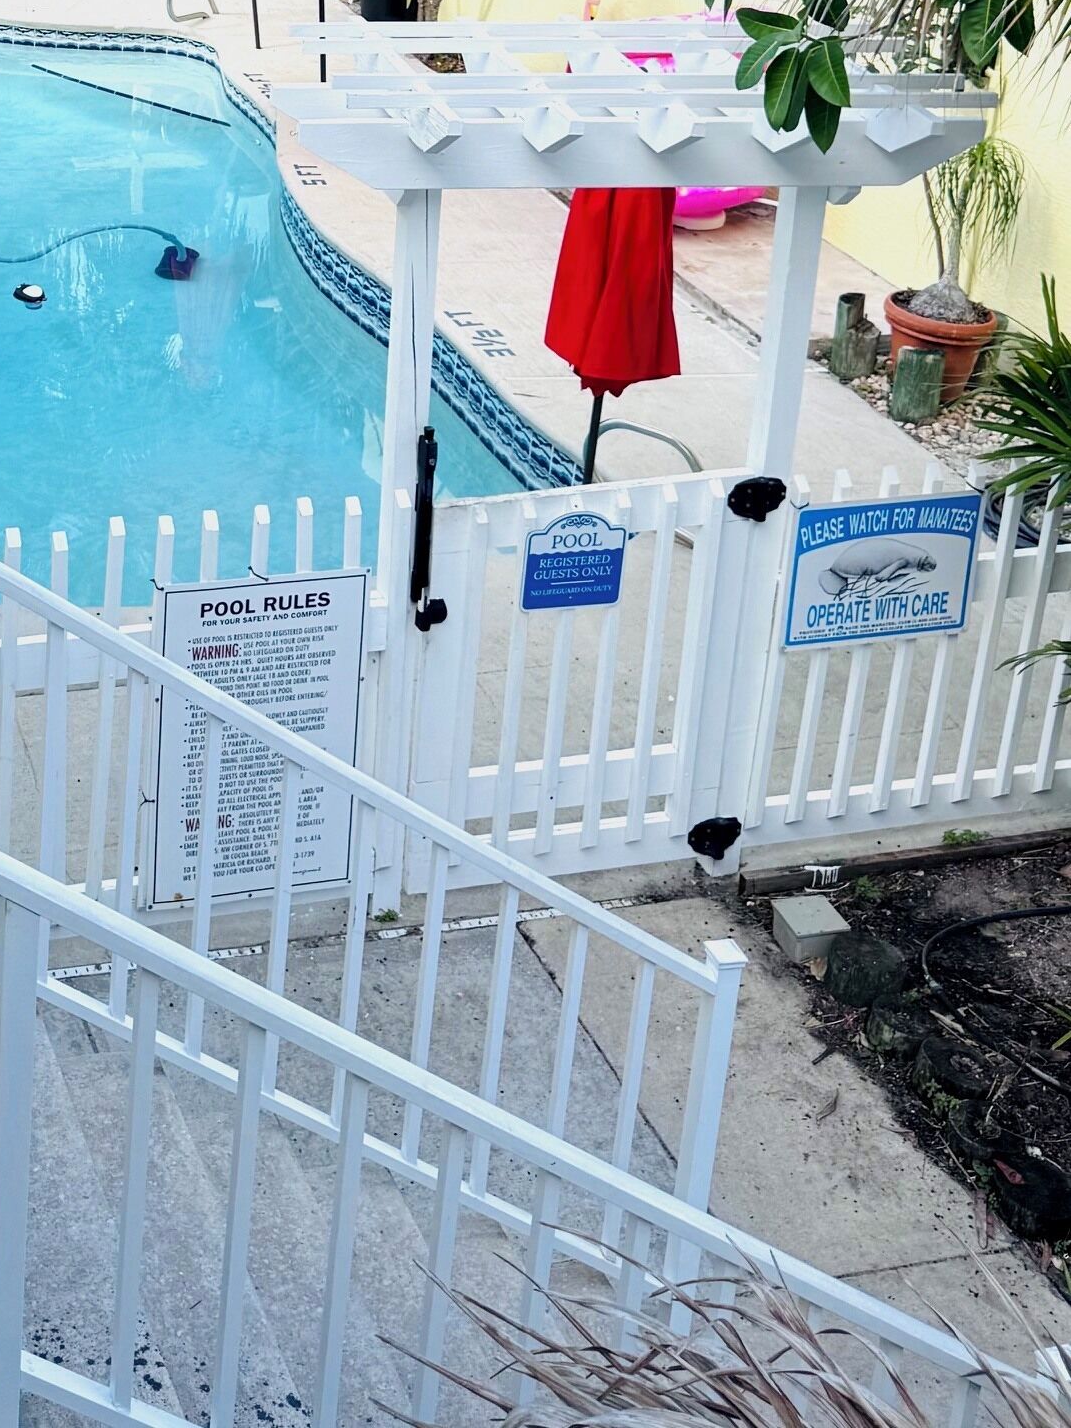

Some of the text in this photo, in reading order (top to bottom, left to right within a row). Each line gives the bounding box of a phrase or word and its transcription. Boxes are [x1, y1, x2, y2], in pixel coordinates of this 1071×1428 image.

[293, 164, 322, 176] FT
[443, 311, 485, 327] FT
[800, 506, 977, 549] PLEASE WATCH FOR MANATEES
[552, 532, 603, 549] POOL
[539, 554, 611, 568] REGISTERED
[533, 565, 613, 581] GUESTS ONLY
[542, 586, 580, 596] LIFEGUARD
[593, 584, 614, 592] DUTY
[200, 591, 331, 618] POOL RULES
[806, 600, 872, 628] OPERATE
[875, 596, 908, 620] WITH
[911, 591, 950, 617] CARE
[201, 609, 327, 627] FOR YOUR SAFETY AND COMFORT
[211, 634, 225, 643] POOL
[233, 631, 263, 641] RESTRICTED
[264, 630, 271, 638] TO
[272, 627, 302, 637] REGISTERED
[303, 625, 323, 634] GUESTS
[323, 624, 338, 632] ONLY
[191, 634, 324, 661] WARNING: USE POOL AT YOUR OWN RISK
[243, 644, 309, 657] NO LIFEGUARD ON DUTY
[191, 662, 205, 670] POOL
[207, 661, 213, 669] IS
[214, 660, 230, 668] OPEN
[256, 655, 273, 664] QUIET
[274, 653, 294, 662] HOURS
[295, 652, 306, 660] ARE
[306, 649, 336, 659] OBSERVED
[221, 668, 228, 676] 10
[229, 667, 238, 675] PM
[250, 665, 260, 673] AM
[261, 663, 273, 672] AND
[275, 662, 285, 670] ARE
[287, 659, 318, 669] RESTRICTED
[319, 658, 331, 666] FOR
[213, 675, 235, 685] ADULTS
[236, 674, 251, 682] ONLY
[276, 670, 289, 678] AND
[262, 680, 269, 688] NO
[270, 679, 284, 687] FOOD
[293, 676, 307, 684] DRINK
[310, 675, 315, 683] IN
[316, 674, 329, 682] POOL
[236, 689, 254, 699] OTHER
[256, 688, 268, 697] OILS
[270, 687, 276, 695] IN
[277, 685, 292, 694] POOL
[274, 693, 295, 702] BEFORE
[286, 706, 328, 717] AND CAUTIOUSLY
[226, 731, 239, 739] AND
[227, 738, 249, 747] PARENT
[250, 737, 257, 745] AT
[187, 752, 200, 760] KEEP
[230, 747, 247, 755] GATES
[240, 754, 254, 762] LOUD
[238, 759, 279, 770] PERMITTED THAT
[224, 780, 236, 788] NOT
[237, 793, 266, 802] ELECTRICAL
[303, 794, 317, 802] AREA
[185, 800, 198, 808] KEEP
[228, 803, 244, 811] FROM
[246, 801, 255, 809] THE
[257, 800, 272, 808] POOL
[238, 809, 272, 819] ABSOLUTELY
[237, 816, 274, 827] THERE IS ANY
[235, 827, 250, 835] POOL
[257, 824, 271, 833] POOL
[252, 832, 277, 841] DIAL 911
[231, 842, 253, 851] CORNER
[254, 841, 261, 849] OF
[230, 850, 249, 859] COCOA
[250, 848, 268, 857] BEACH
[236, 859, 244, 867] OR
[213, 869, 225, 877] YOU
[225, 868, 237, 876] FOR
[238, 865, 254, 874] YOUR
